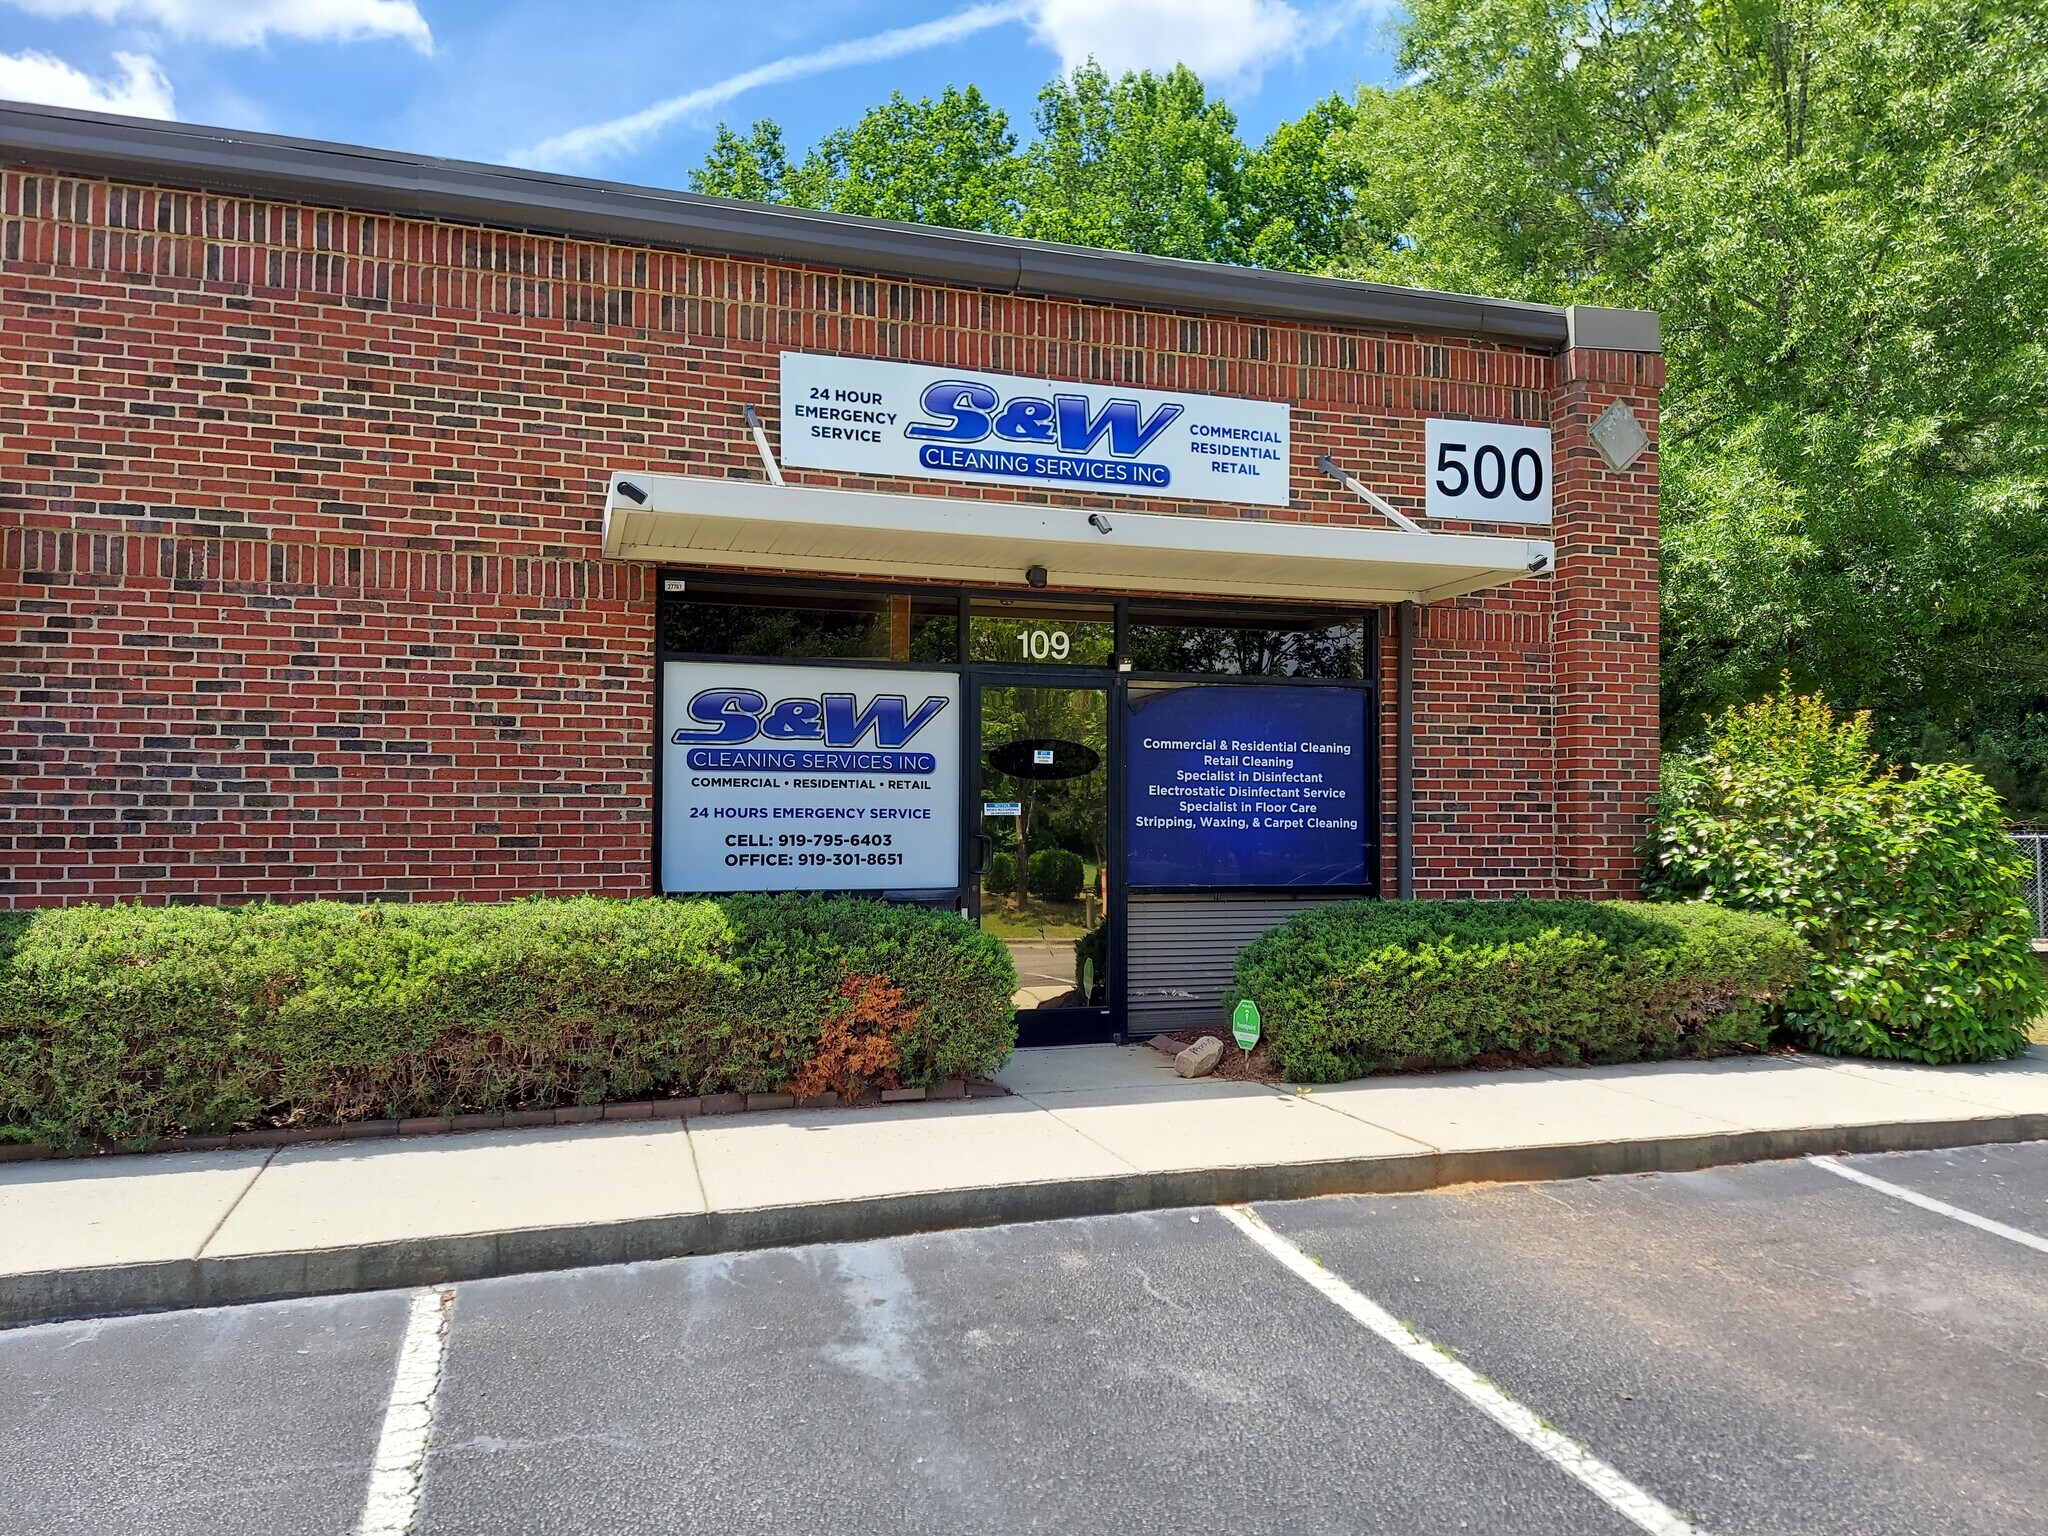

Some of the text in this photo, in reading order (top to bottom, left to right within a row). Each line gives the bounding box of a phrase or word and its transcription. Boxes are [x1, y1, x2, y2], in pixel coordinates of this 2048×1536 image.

[810, 388, 883, 405] 24 HOUR
[795, 405, 897, 425] EMERGENCY
[904, 380, 1184, 458] S&W
[811, 426, 881, 443] SERVICE
[1190, 425, 1282, 444] COMMERCIAL
[1191, 443, 1280, 461] RESIDENTIAL
[927, 449, 1164, 483] CLEANING SERVICES INC
[1212, 461, 1260, 476] RETAIL
[1436, 443, 1542, 501] 500
[1017, 631, 1069, 659] 109
[671, 688, 949, 748] S&W
[1143, 738, 1351, 755] Commercial & Residential Cleaning
[693, 752, 929, 770] CLEANING SERVICES INC
[1204, 755, 1293, 769] Retail Cleaning
[691, 778, 931, 789] COMMERCIAL RESIDENTIAL RETAIL
[1177, 770, 1323, 783] Specialist in Disinfectant
[1149, 785, 1346, 798] Electrostatic Disinfectant Service
[690, 808, 931, 819] 24 HOURS EMERGENCY SERVICE
[1179, 801, 1317, 813] Specialist in Floor Care
[1136, 816, 1357, 830] Stripping, Waxing, & Carpet Cleaning
[725, 834, 892, 846] CELL: 919-795-6403
[725, 853, 902, 866] OFFICE: 919-301-8651
